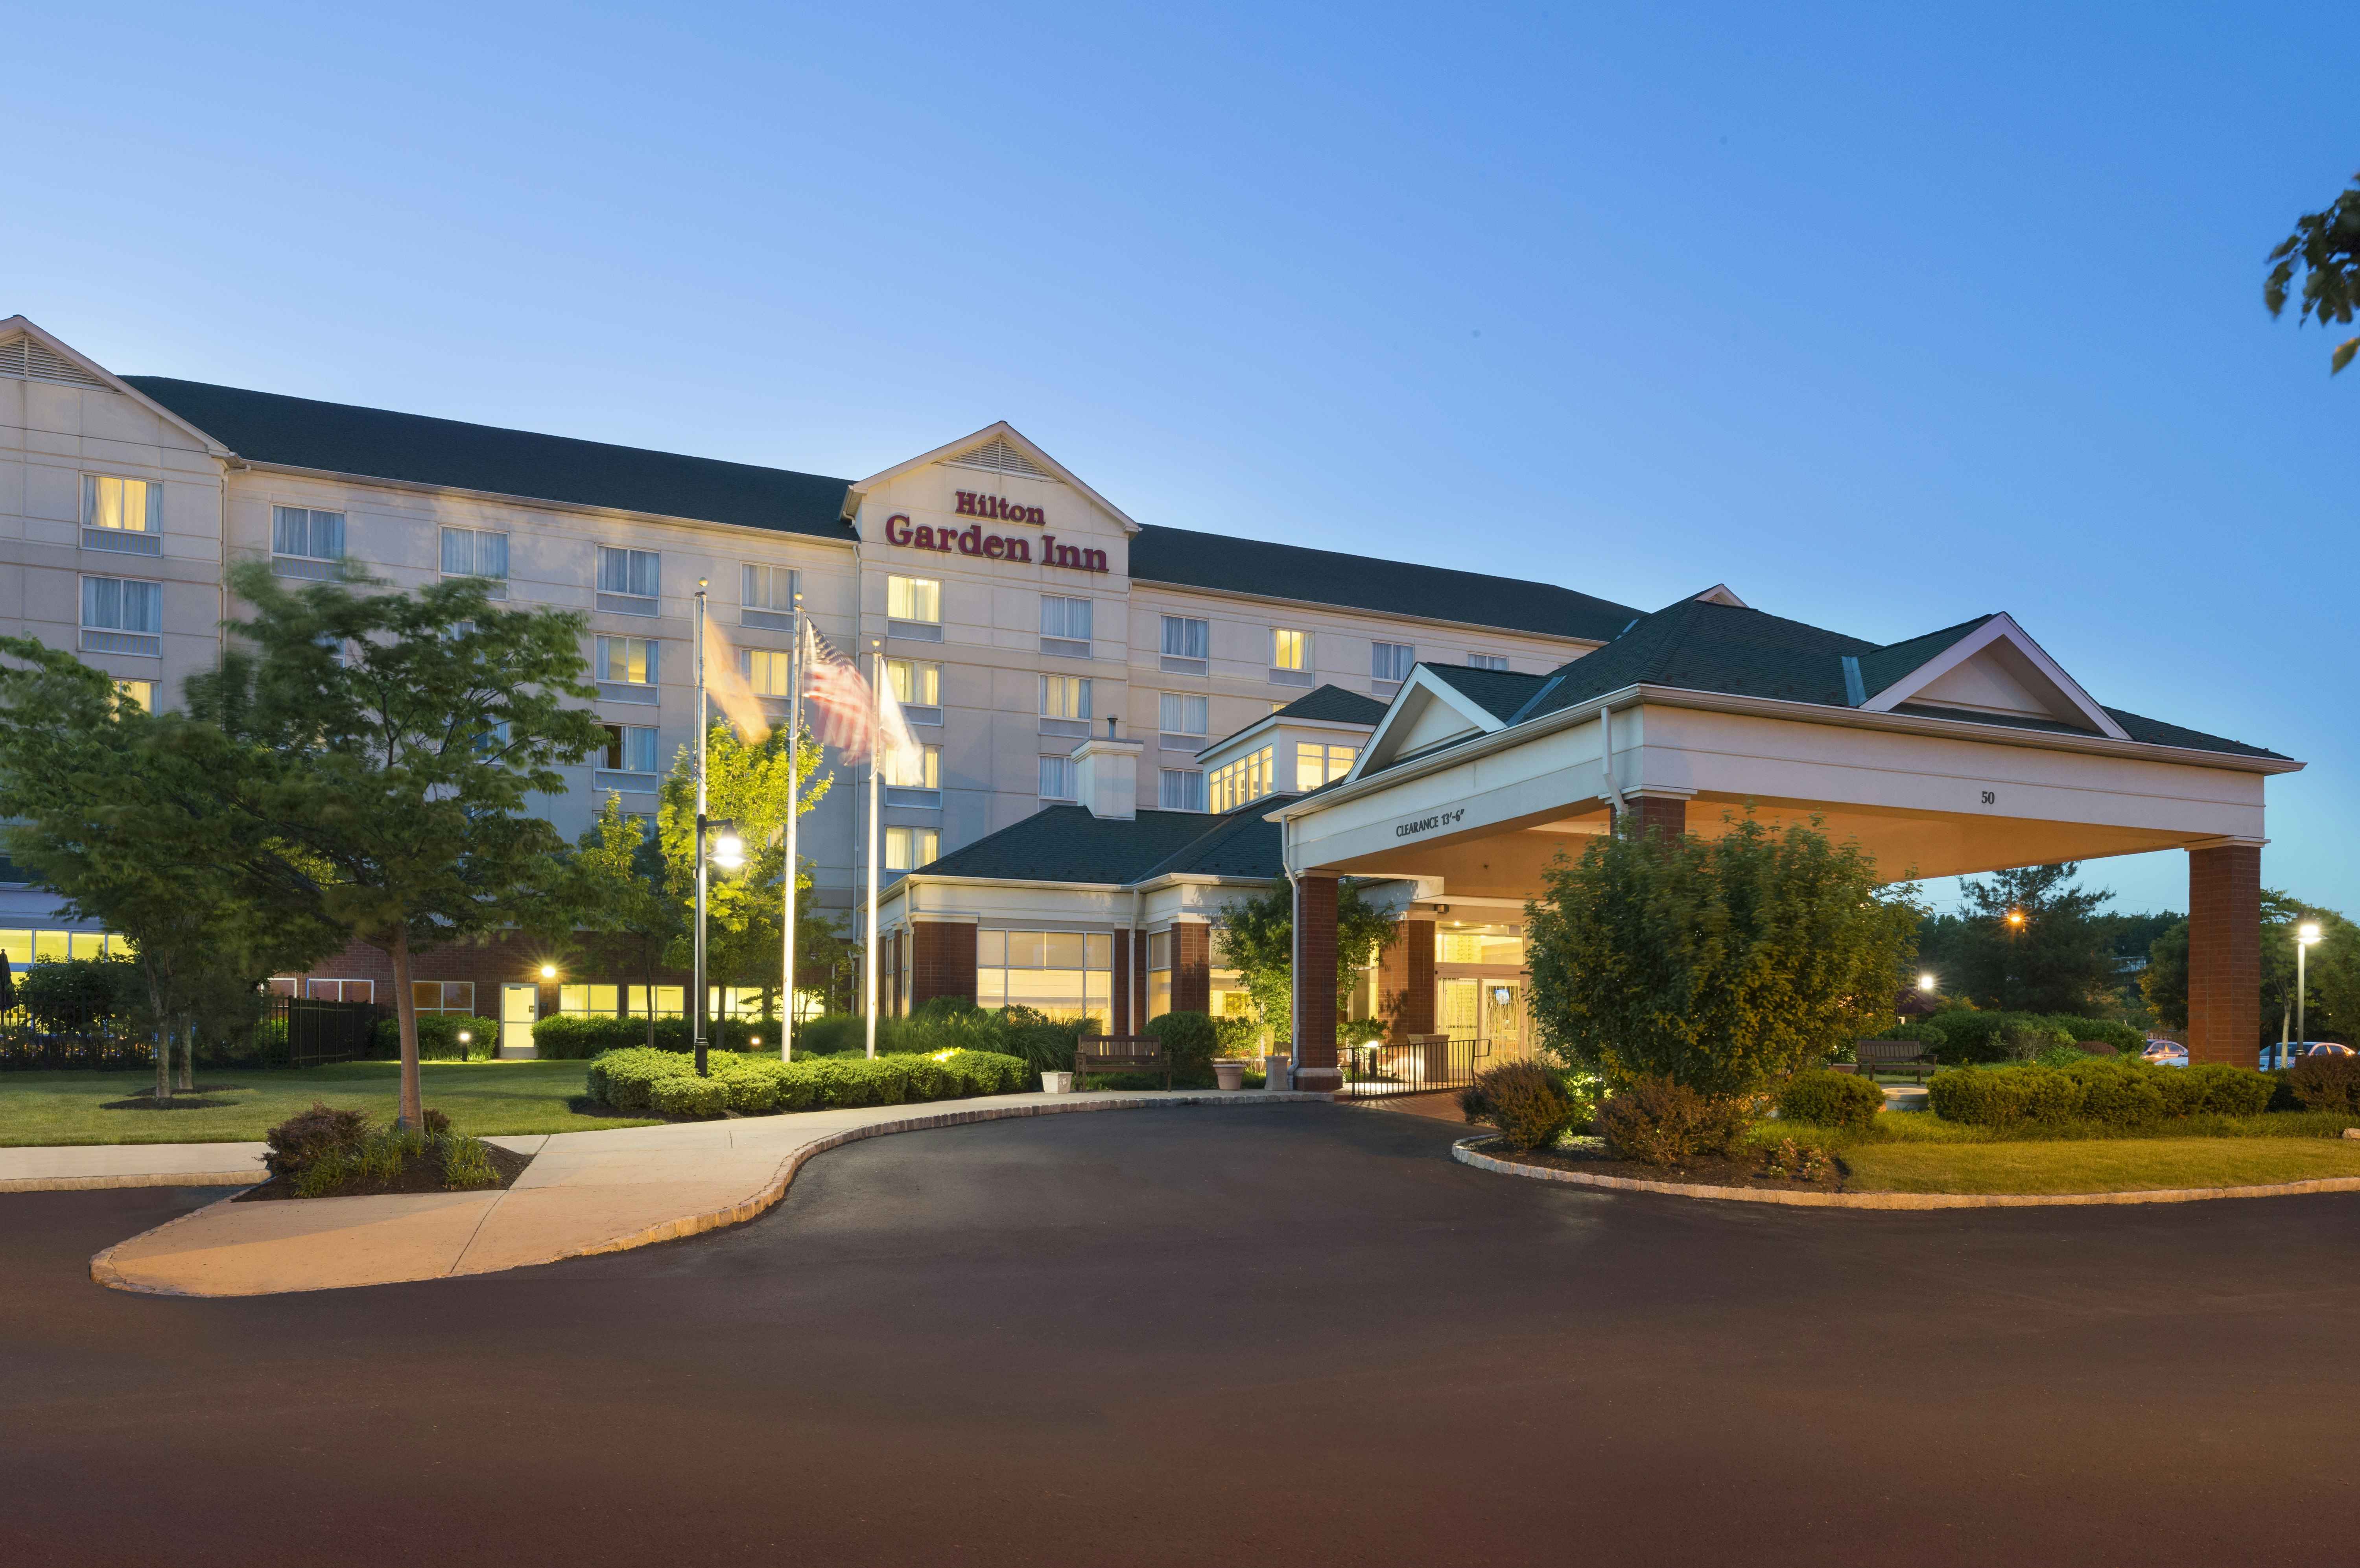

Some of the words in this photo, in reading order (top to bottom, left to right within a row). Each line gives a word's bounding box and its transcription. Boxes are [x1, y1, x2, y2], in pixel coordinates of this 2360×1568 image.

[955, 488, 1046, 526] Hilton
[885, 512, 1032, 562] Garden
[1040, 533, 1110, 573] Inn
[1981, 791, 1995, 804] 50
[1396, 816, 1438, 837] CLEARANCE
